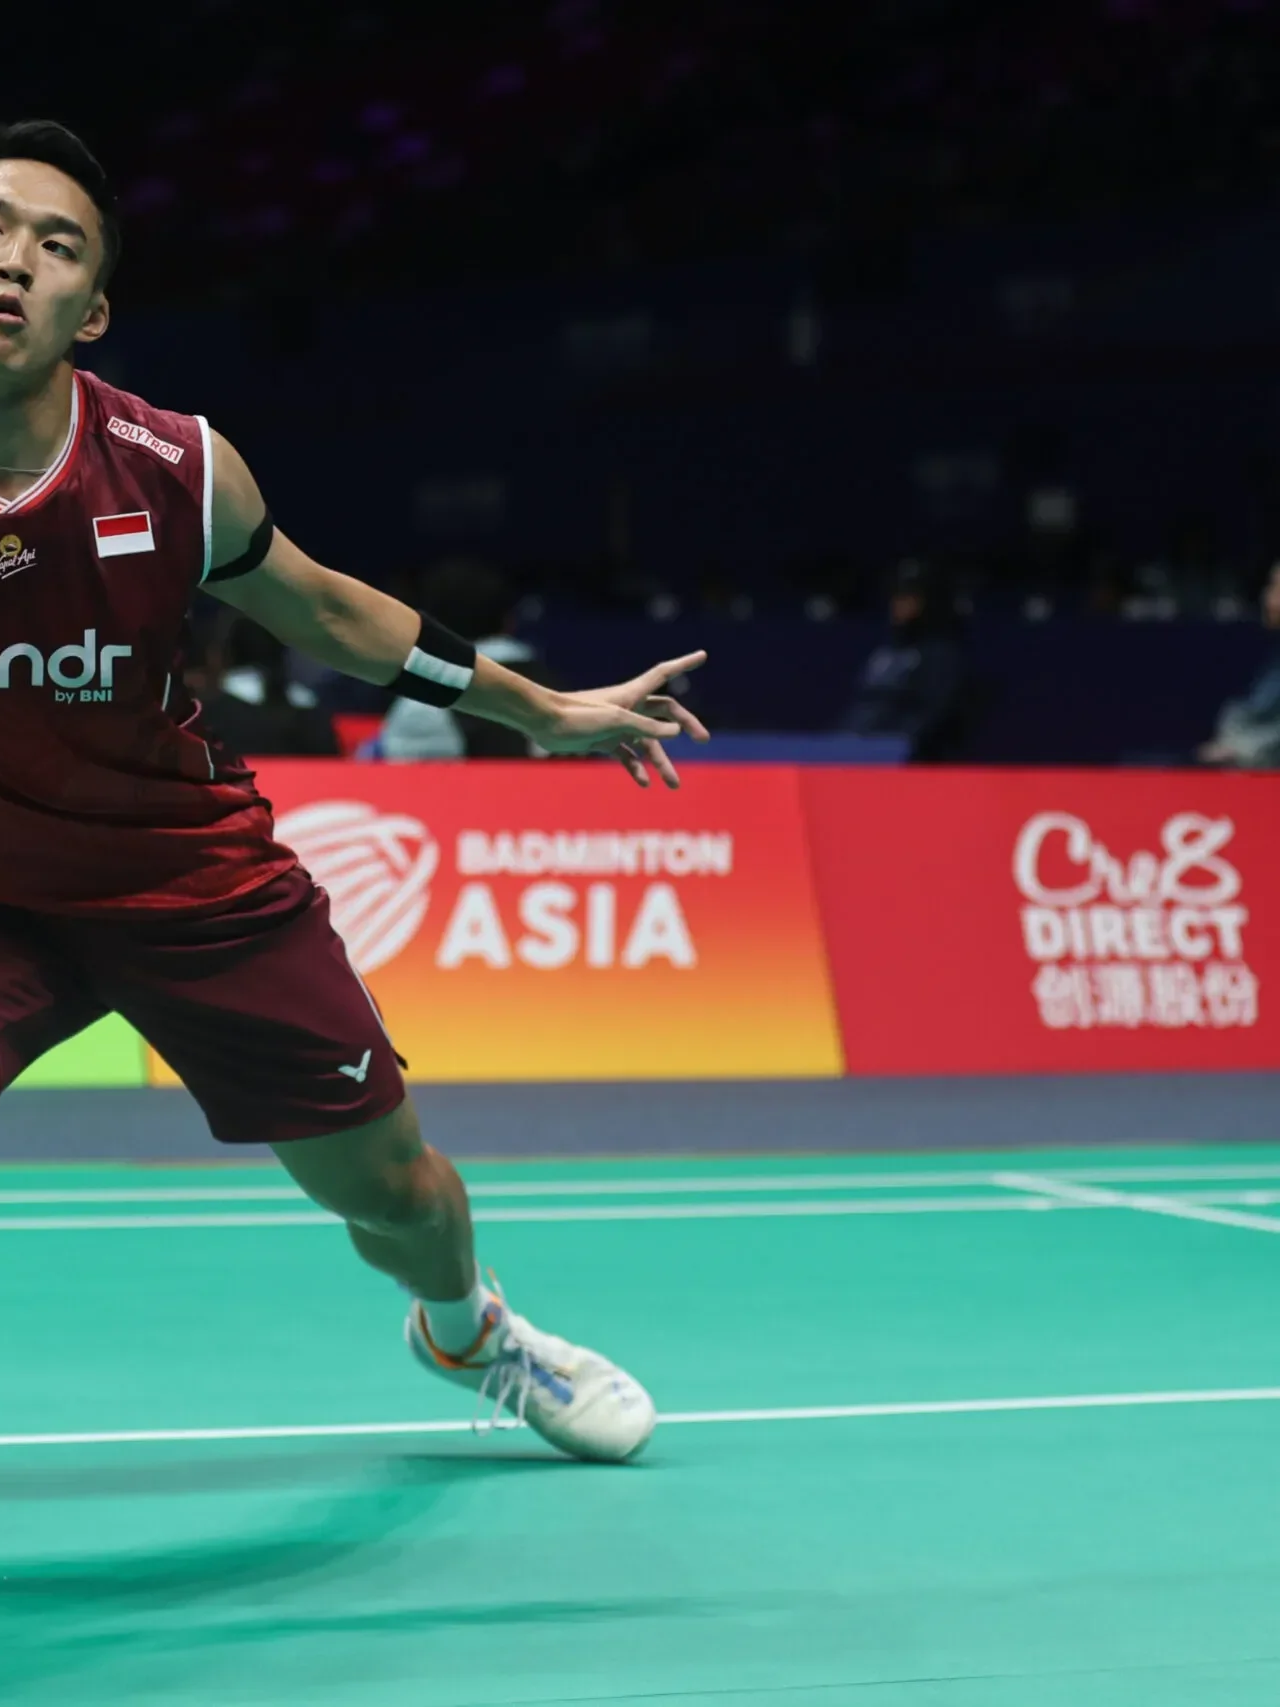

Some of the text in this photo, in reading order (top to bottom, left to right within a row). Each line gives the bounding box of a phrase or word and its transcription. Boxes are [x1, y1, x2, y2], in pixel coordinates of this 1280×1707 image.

[109, 419, 181, 462] POLYTRON
[55, 689, 113, 704] by BNI
[457, 831, 733, 875] BADMINTON
[436, 882, 696, 969] ASIA
[1021, 904, 1249, 960] DIRECT
